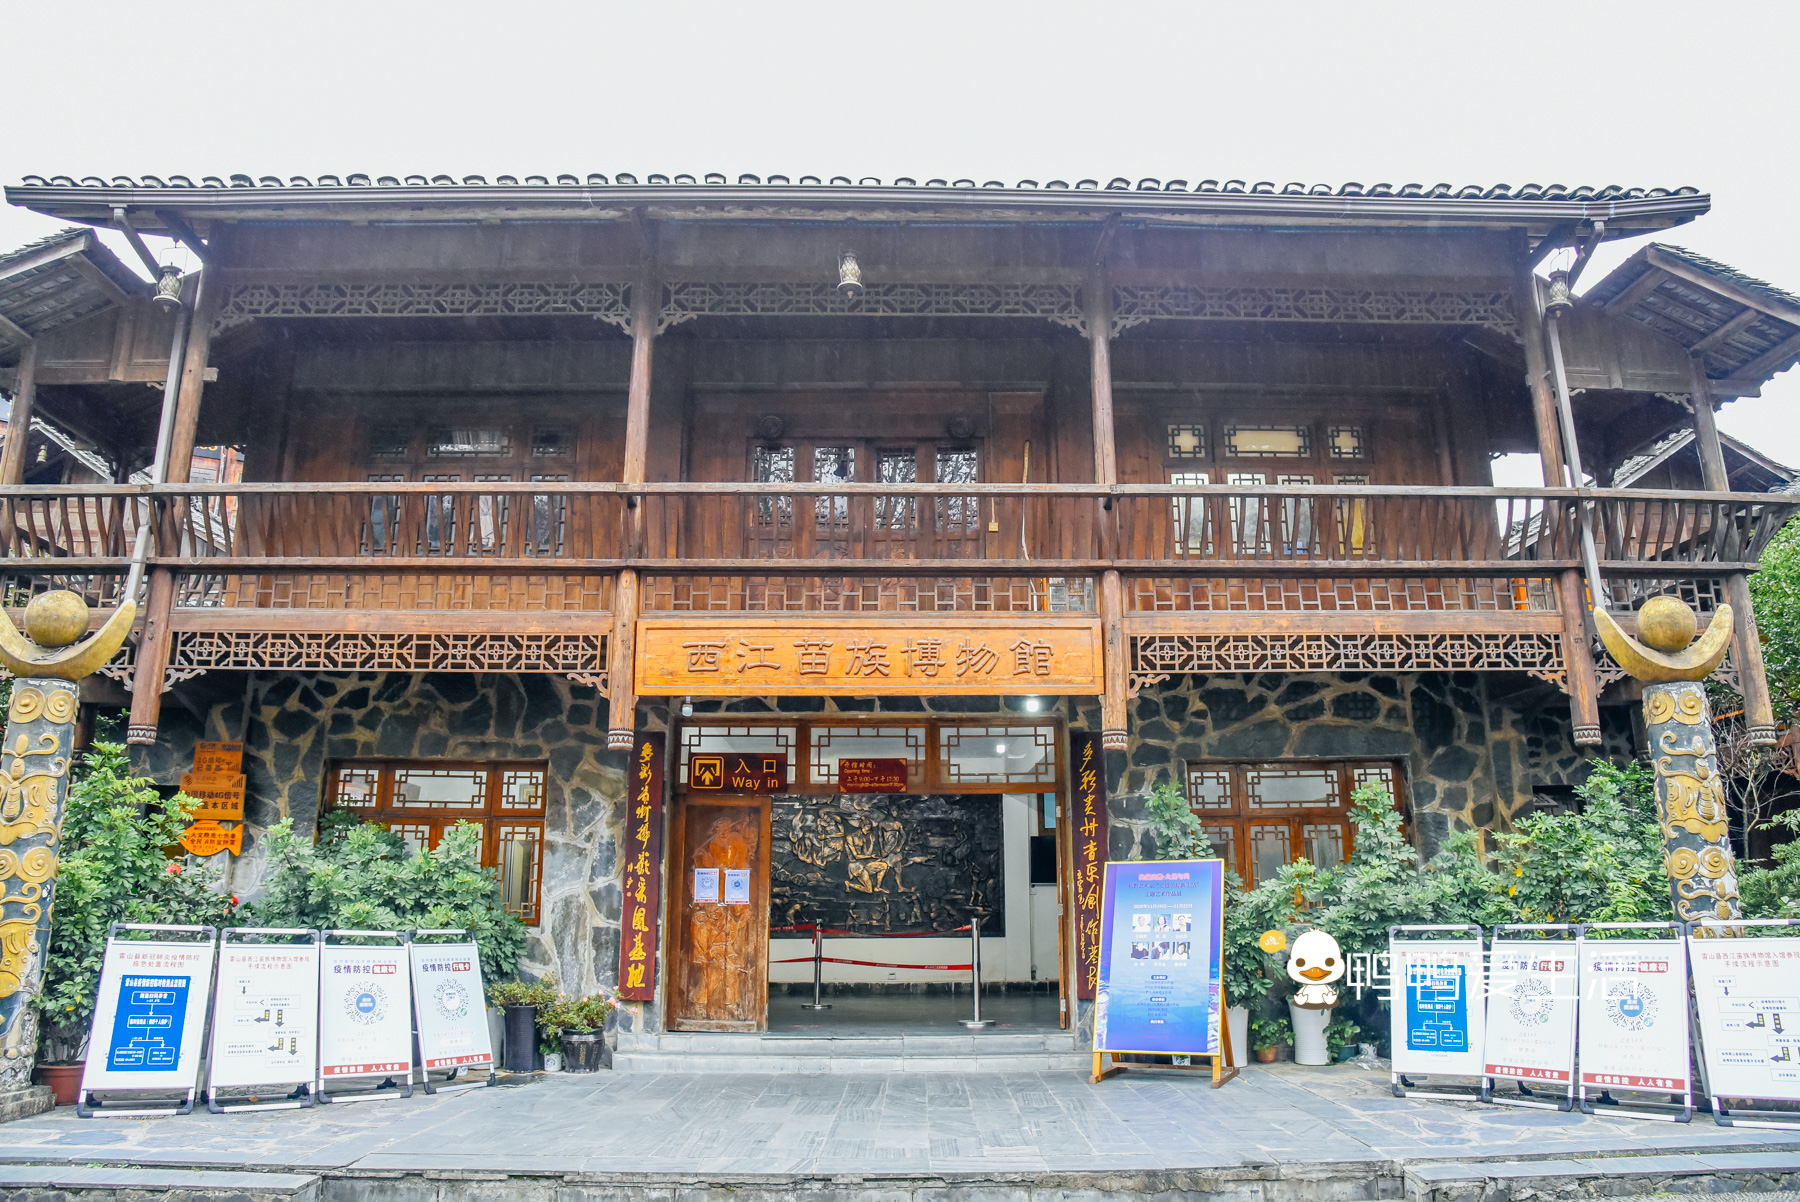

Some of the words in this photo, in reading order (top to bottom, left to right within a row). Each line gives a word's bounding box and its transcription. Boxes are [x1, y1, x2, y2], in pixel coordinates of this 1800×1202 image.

[682, 637, 1055, 677] 西江苗族博物館
[734, 758, 777, 774] 入口
[732, 776, 761, 790] Way
[767, 776, 779, 788] in
[333, 964, 371, 974] 疫情防控
[422, 963, 452, 972] 疫情防控
[434, 1058, 457, 1067] 疫情防控
[333, 1065, 364, 1074] 疫情防控
[1495, 1066, 1523, 1076] 疫情防控
[1595, 1075, 1629, 1085] 疫情防控
